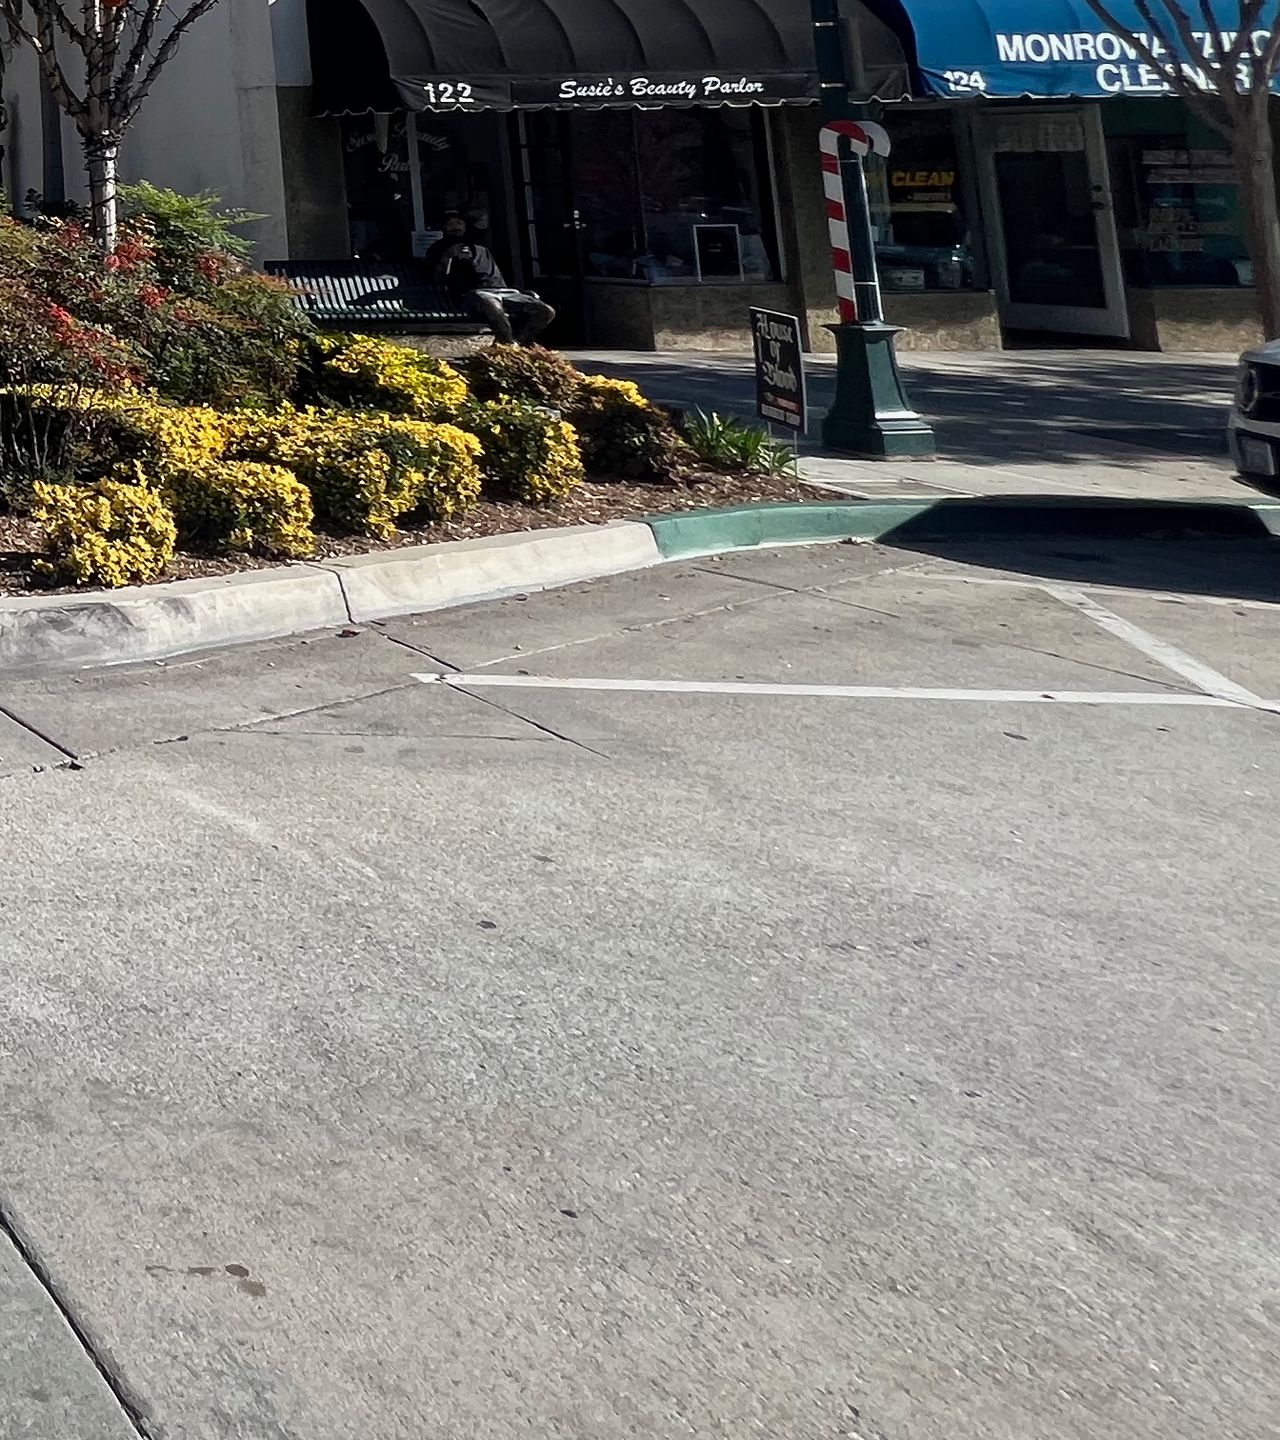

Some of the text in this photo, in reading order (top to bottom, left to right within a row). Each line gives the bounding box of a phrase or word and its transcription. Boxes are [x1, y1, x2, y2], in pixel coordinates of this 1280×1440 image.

[559, 76, 765, 99] Susie's Beauty Parlor
[942, 70, 986, 91] 124
[424, 82, 475, 103] 122
[891, 170, 955, 187] CLEAN
